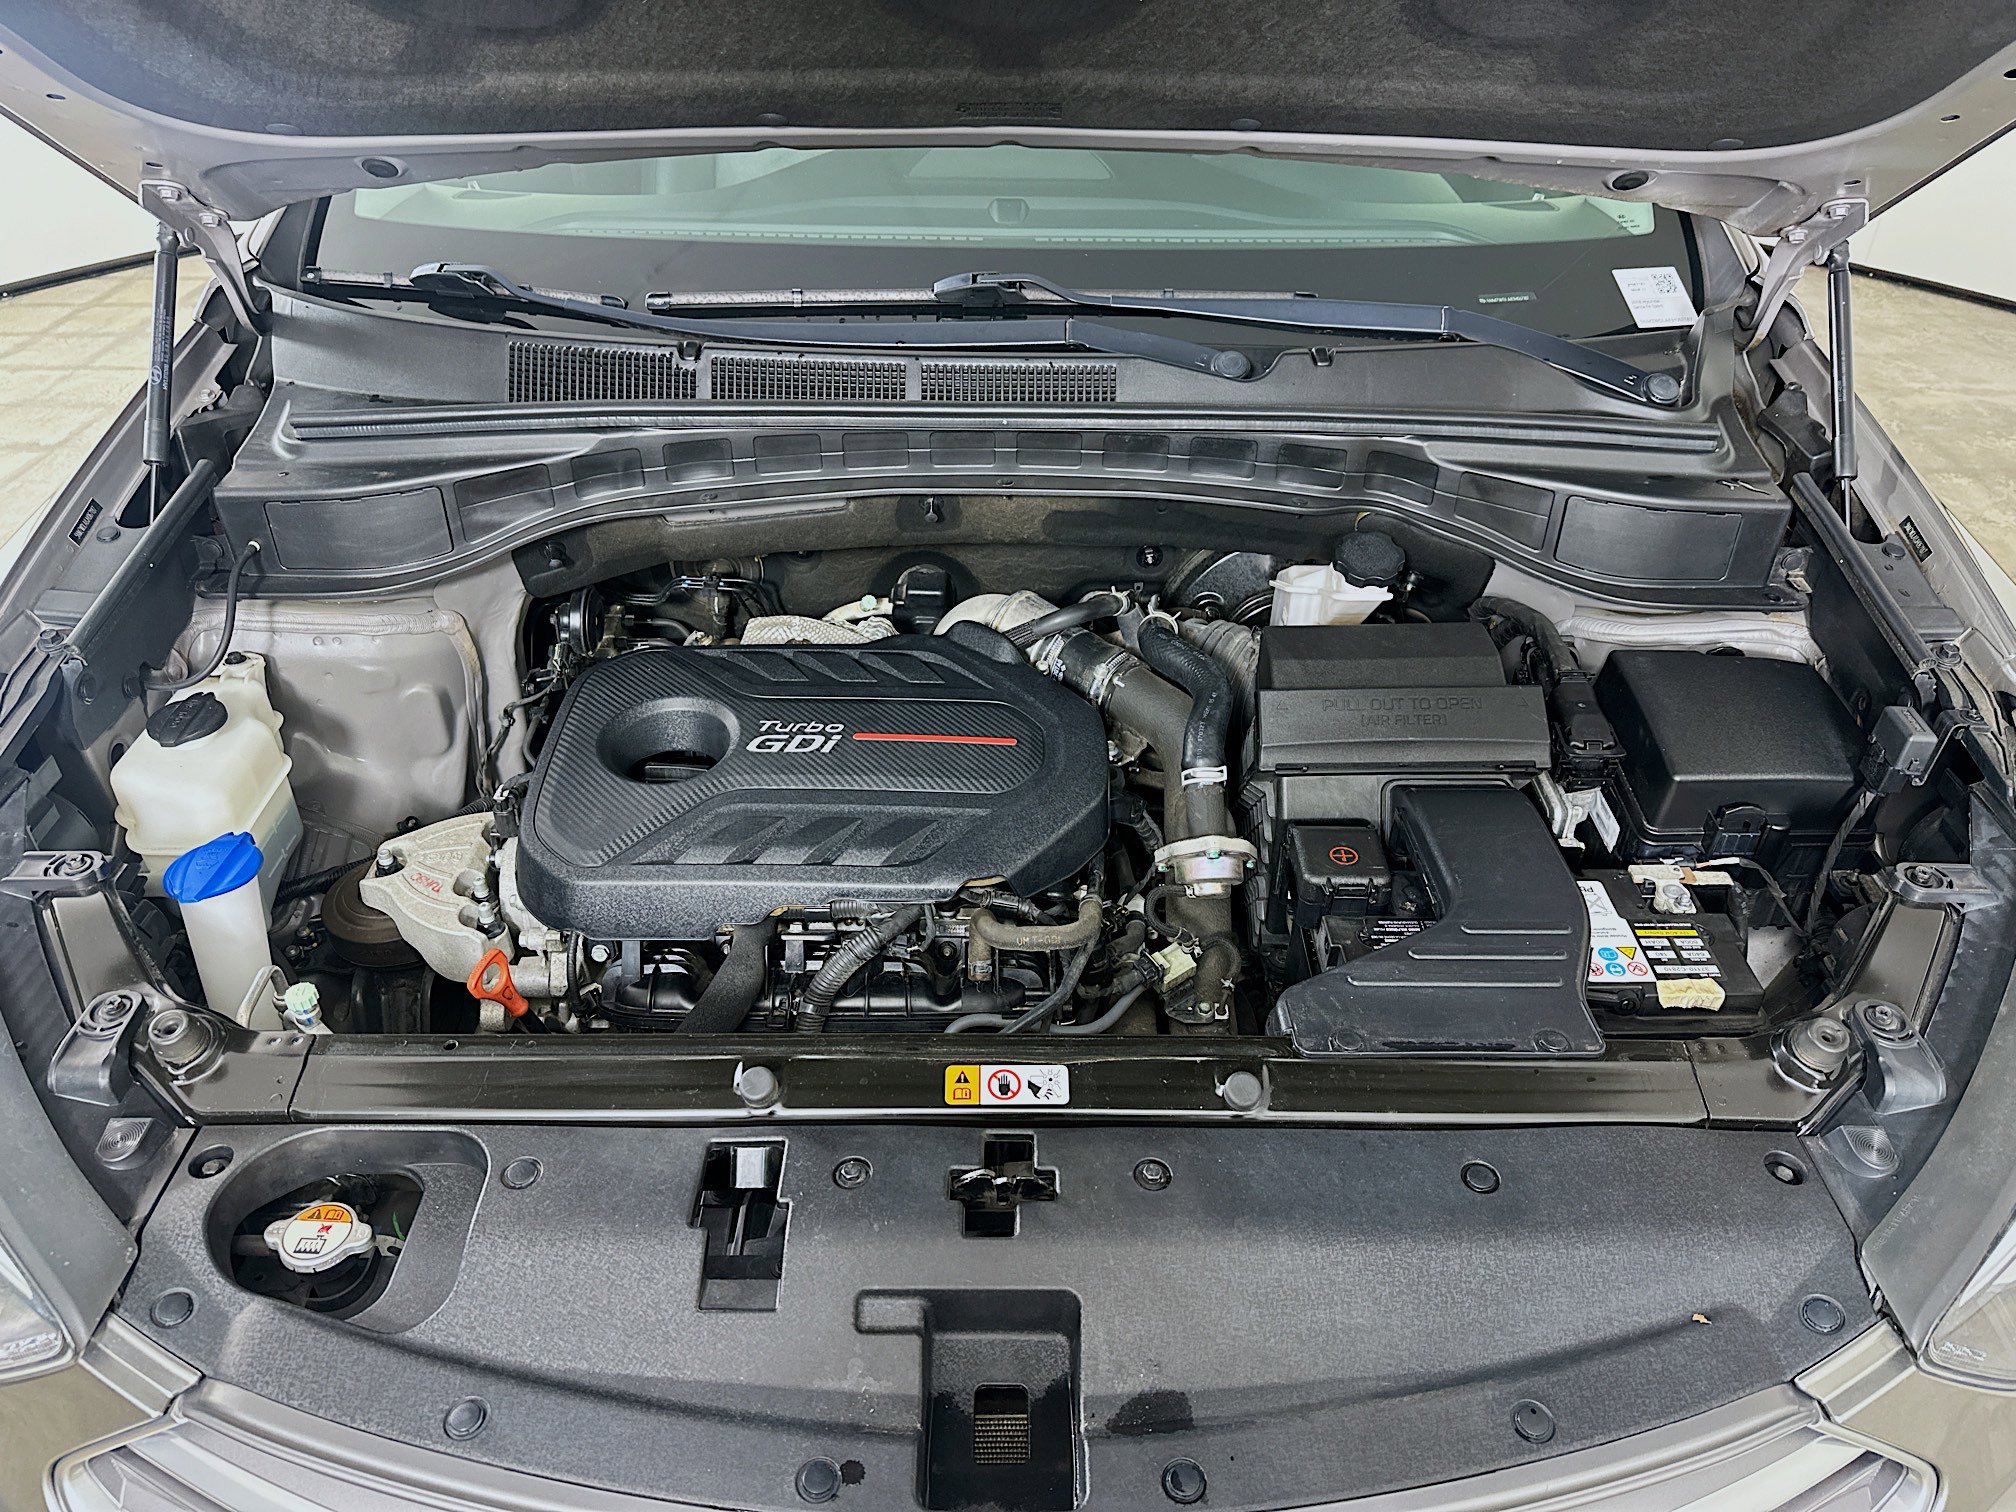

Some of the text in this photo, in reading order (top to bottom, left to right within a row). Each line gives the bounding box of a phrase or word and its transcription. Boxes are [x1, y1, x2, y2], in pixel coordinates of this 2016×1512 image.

[1323, 697, 1483, 711] PULL OUT TO OPEN
[759, 720, 845, 732] Turbo
[745, 734, 843, 753] GDi
